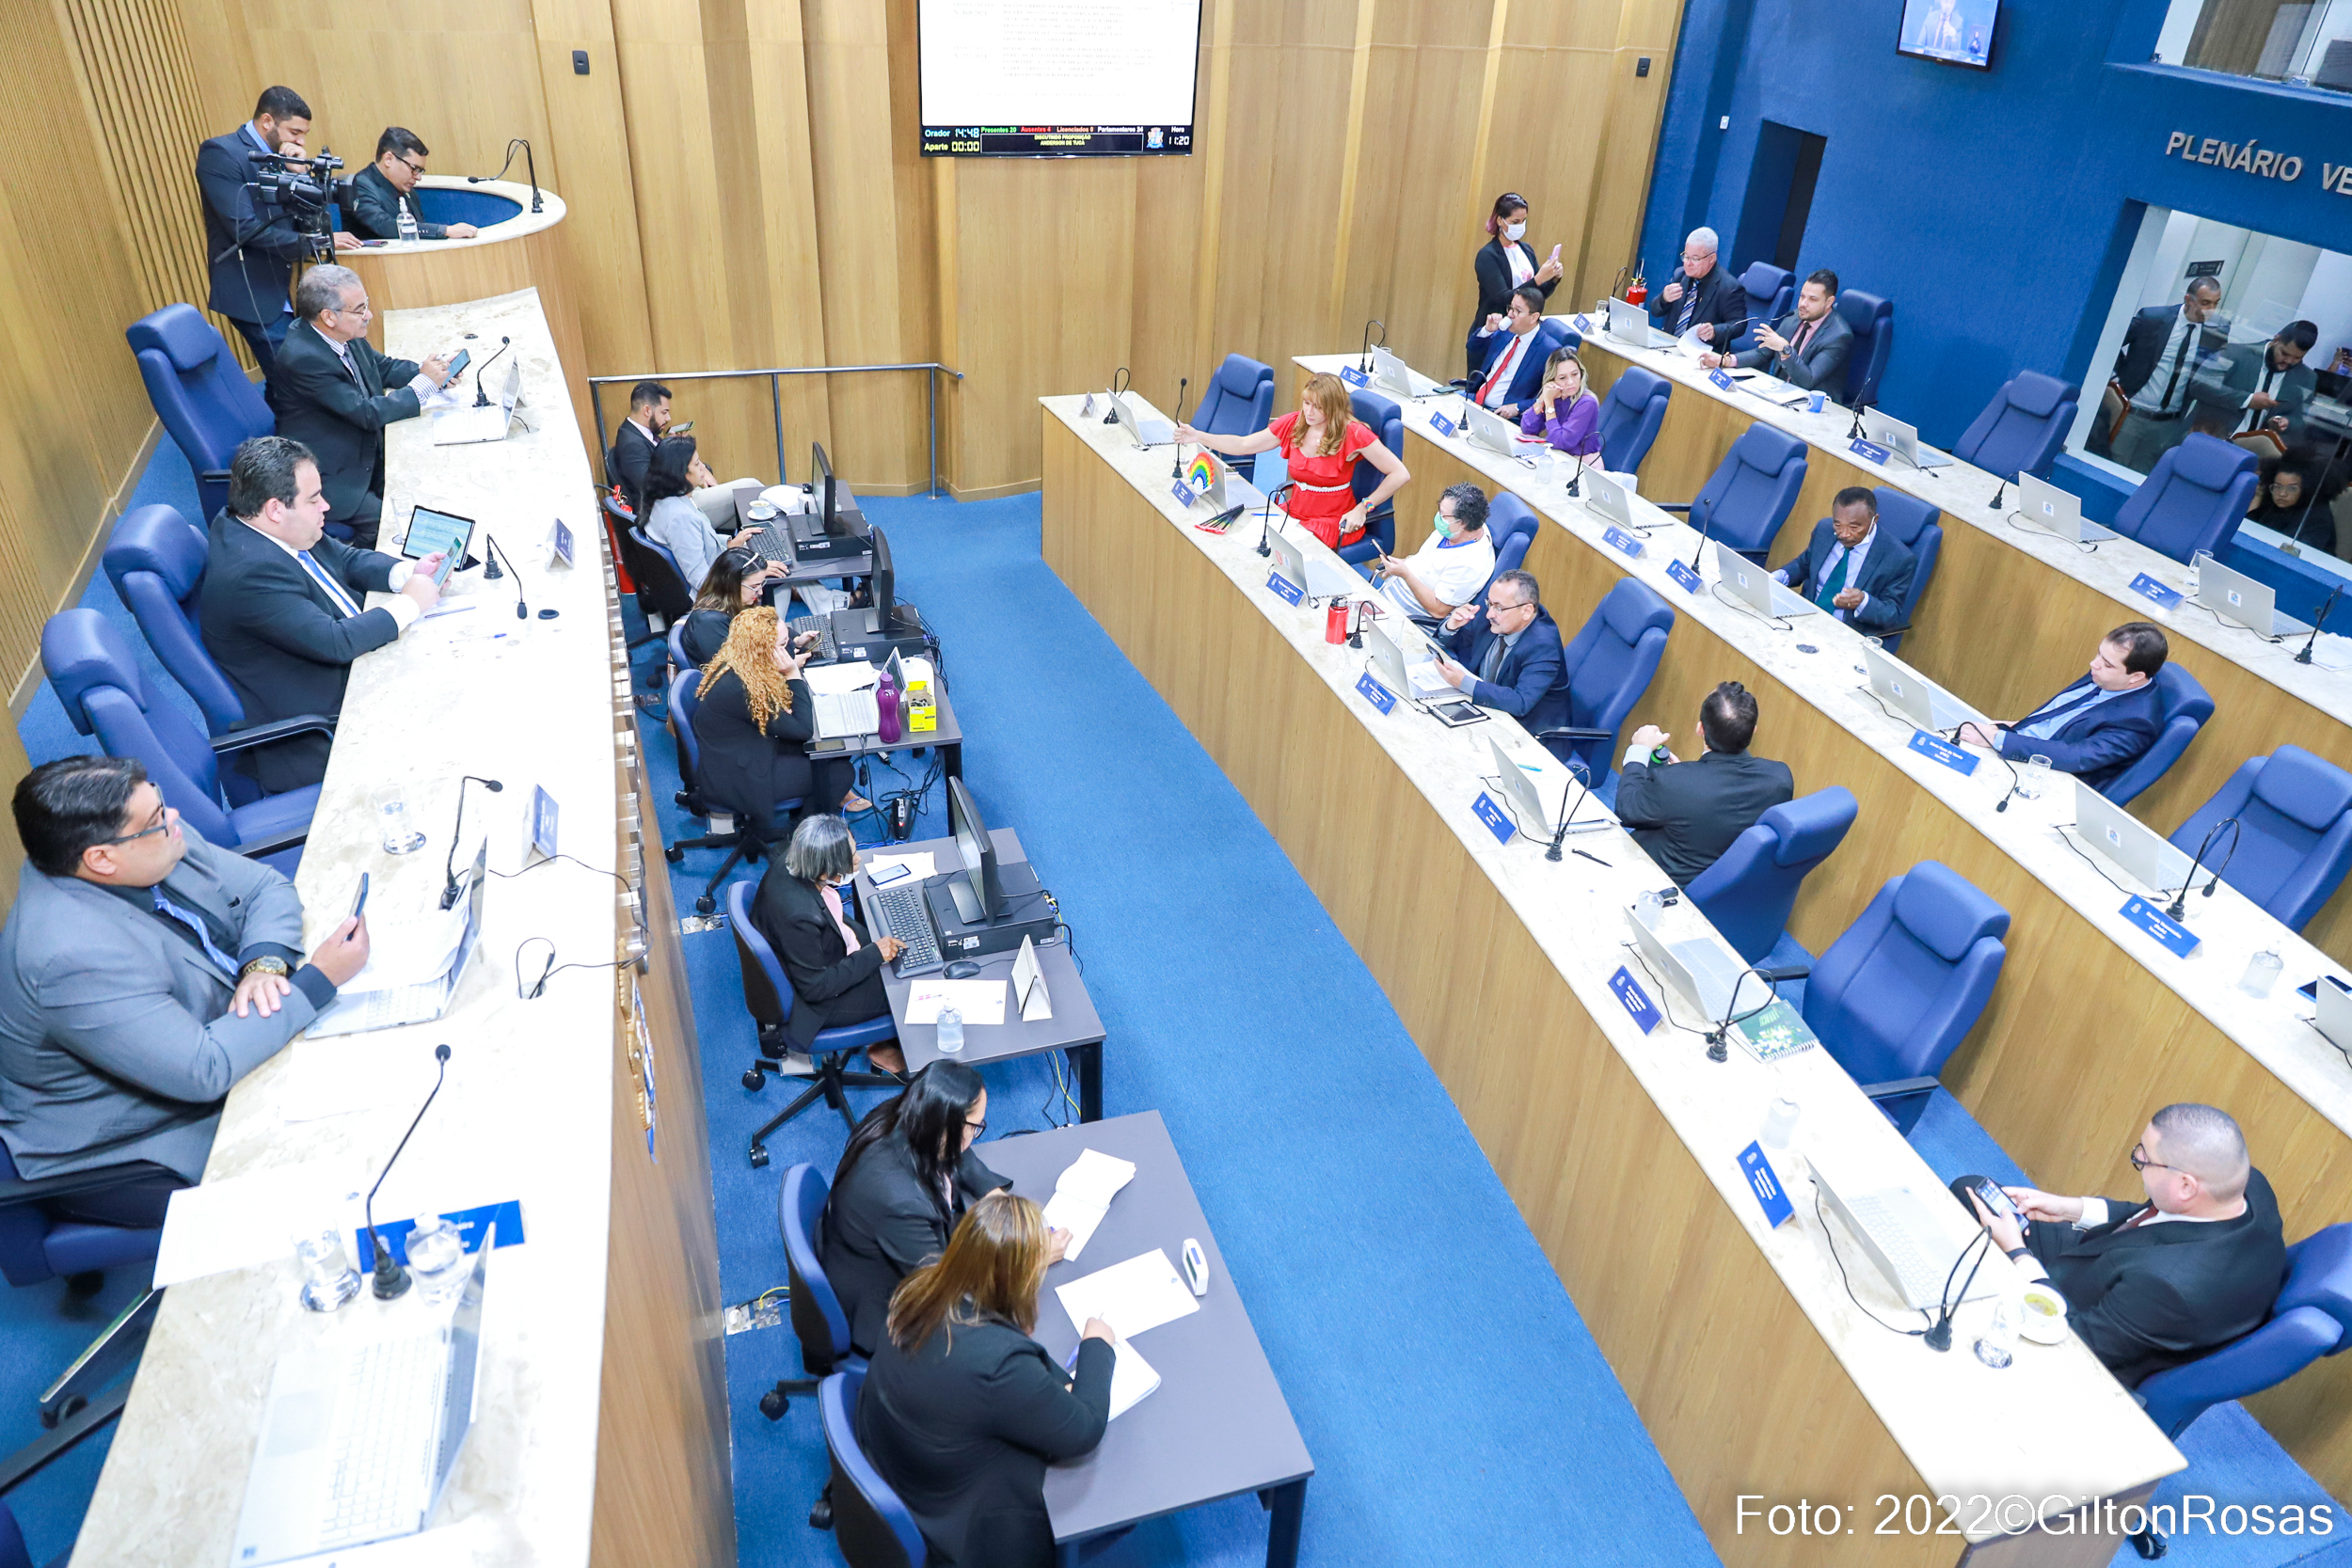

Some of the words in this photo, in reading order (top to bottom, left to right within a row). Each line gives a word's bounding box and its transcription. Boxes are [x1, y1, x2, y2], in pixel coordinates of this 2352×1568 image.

[924, 129, 951, 137] Orador
[954, 127, 980, 138] 14:48
[1168, 135, 1190, 146] 11:20
[924, 143, 949, 152] Aparte
[951, 141, 980, 152] 00:00
[2165, 131, 2303, 182] PLENÁRIO
